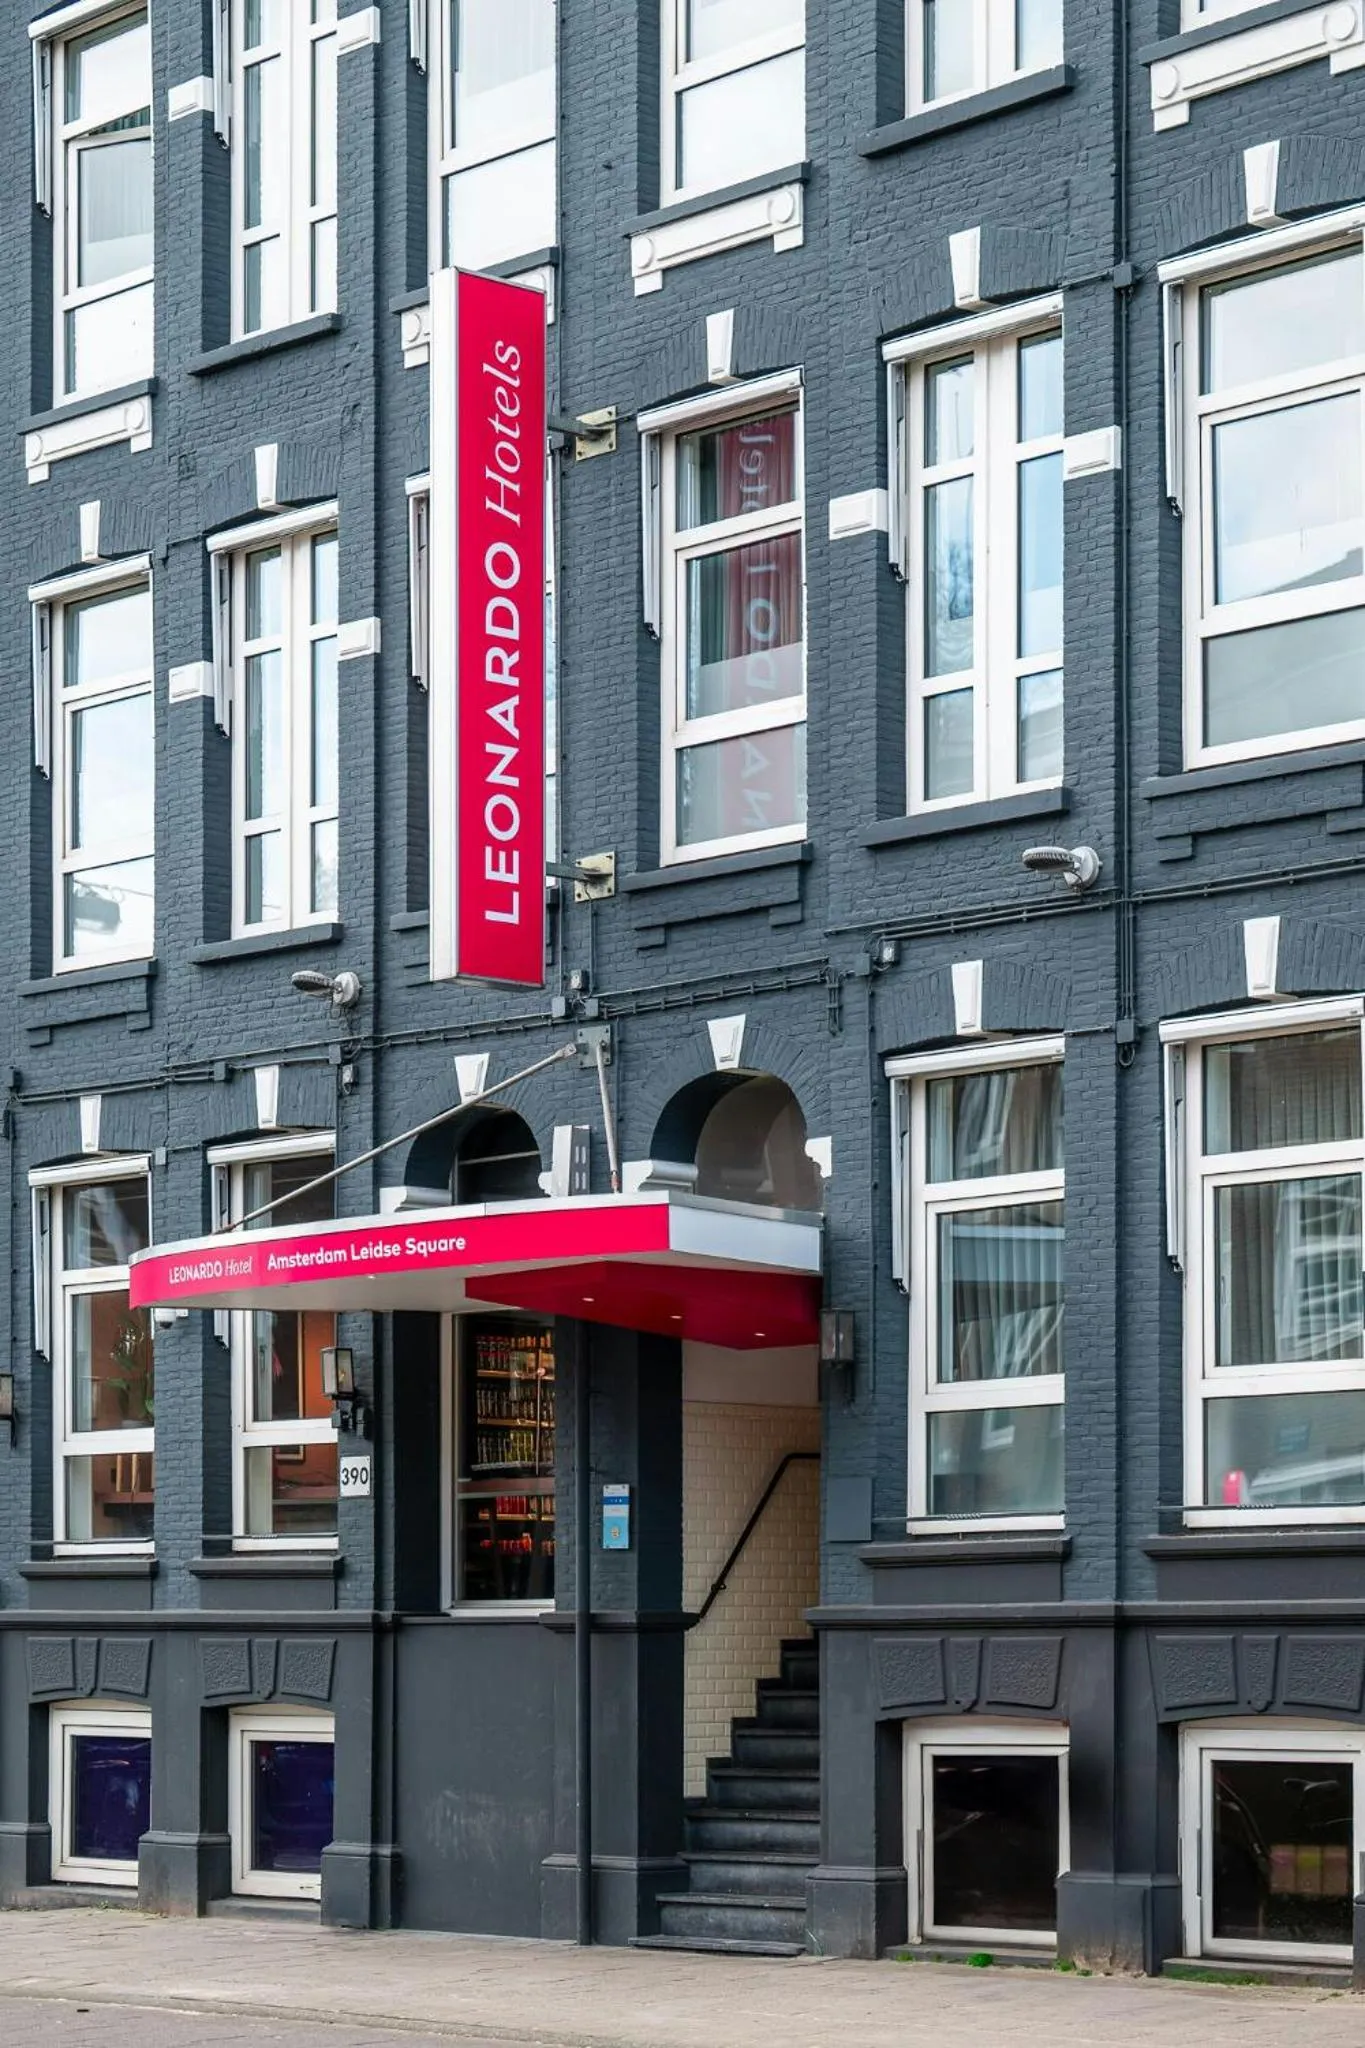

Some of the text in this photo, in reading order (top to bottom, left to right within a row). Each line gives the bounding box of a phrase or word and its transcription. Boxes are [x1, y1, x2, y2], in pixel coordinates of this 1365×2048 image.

[482, 340, 521, 925] LEONARDO Hotels
[267, 1237, 467, 1271] Amsterdam Leidse Square
[169, 1256, 253, 1285] LEONARDO Hotel
[342, 1466, 369, 1485] 390
